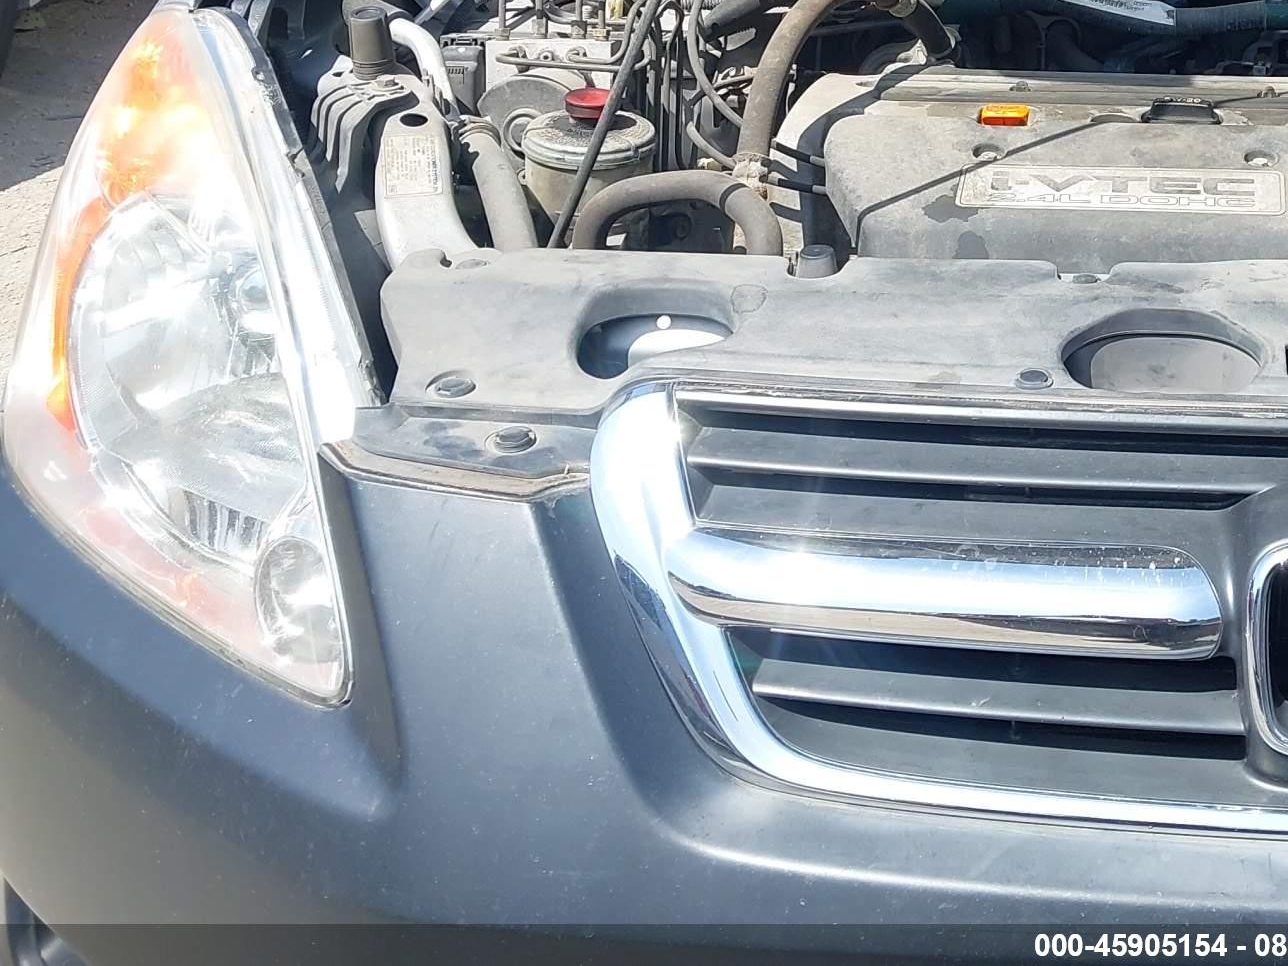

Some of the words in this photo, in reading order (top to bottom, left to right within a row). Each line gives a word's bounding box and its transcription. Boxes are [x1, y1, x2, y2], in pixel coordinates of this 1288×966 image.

[990, 170, 1255, 197] i-VTEC
[986, 192, 1092, 205] 2.4L
[1099, 194, 1256, 208] DOHC
